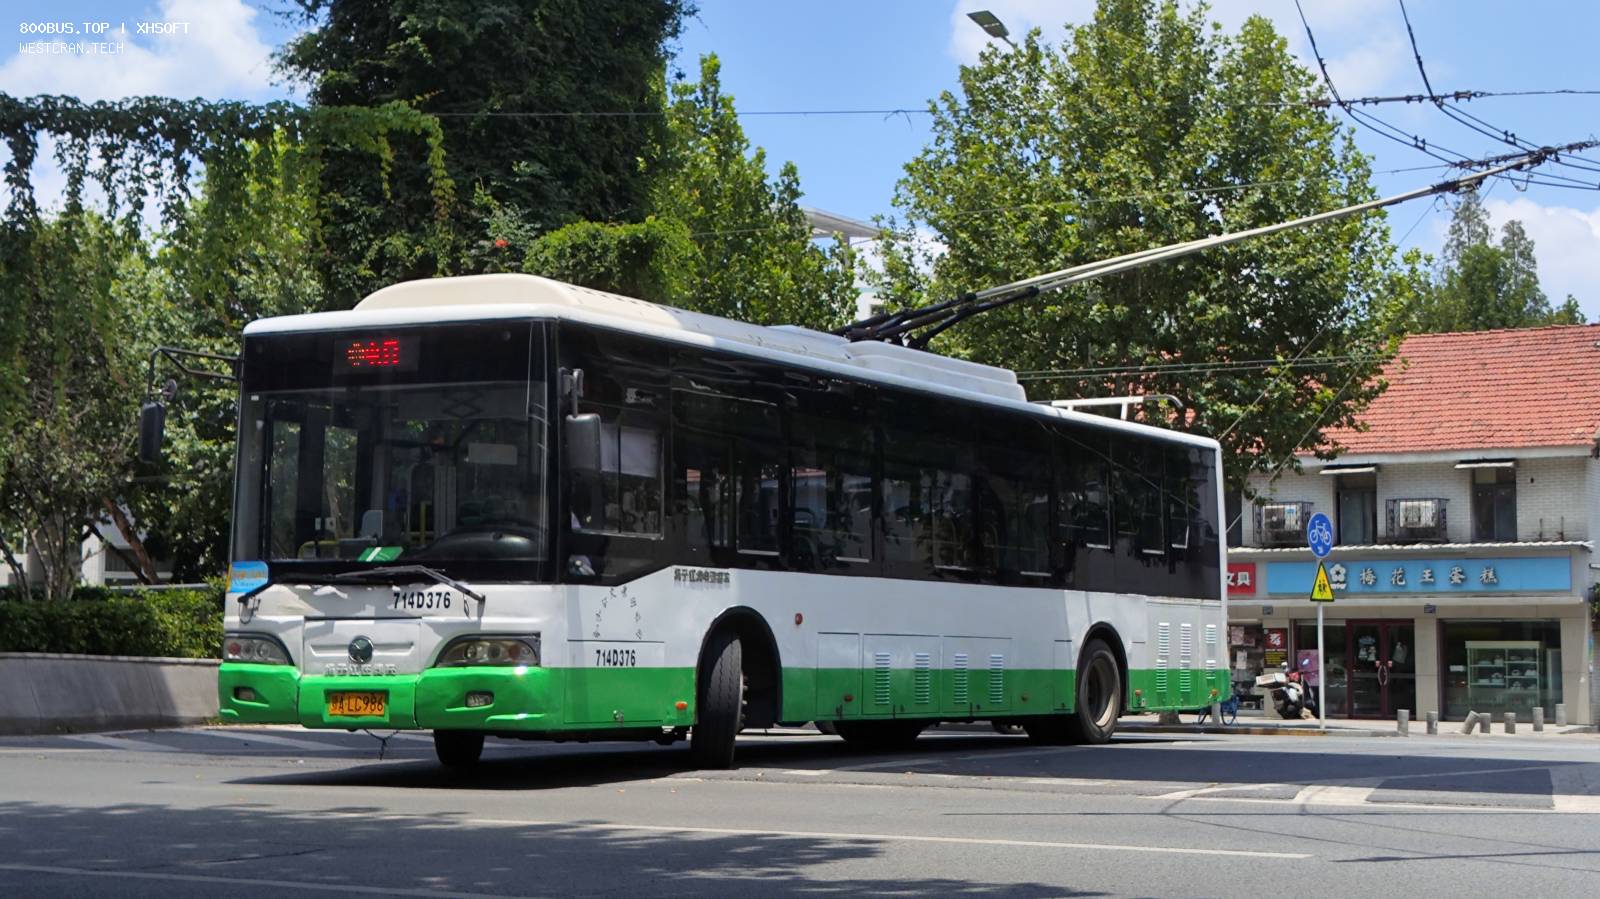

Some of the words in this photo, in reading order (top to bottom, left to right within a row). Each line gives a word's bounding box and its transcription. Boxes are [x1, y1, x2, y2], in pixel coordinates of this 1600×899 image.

[1359, 566, 1498, 585] 梅花王蛋糕
[393, 592, 451, 609] 714D376
[596, 649, 636, 667] 714D376
